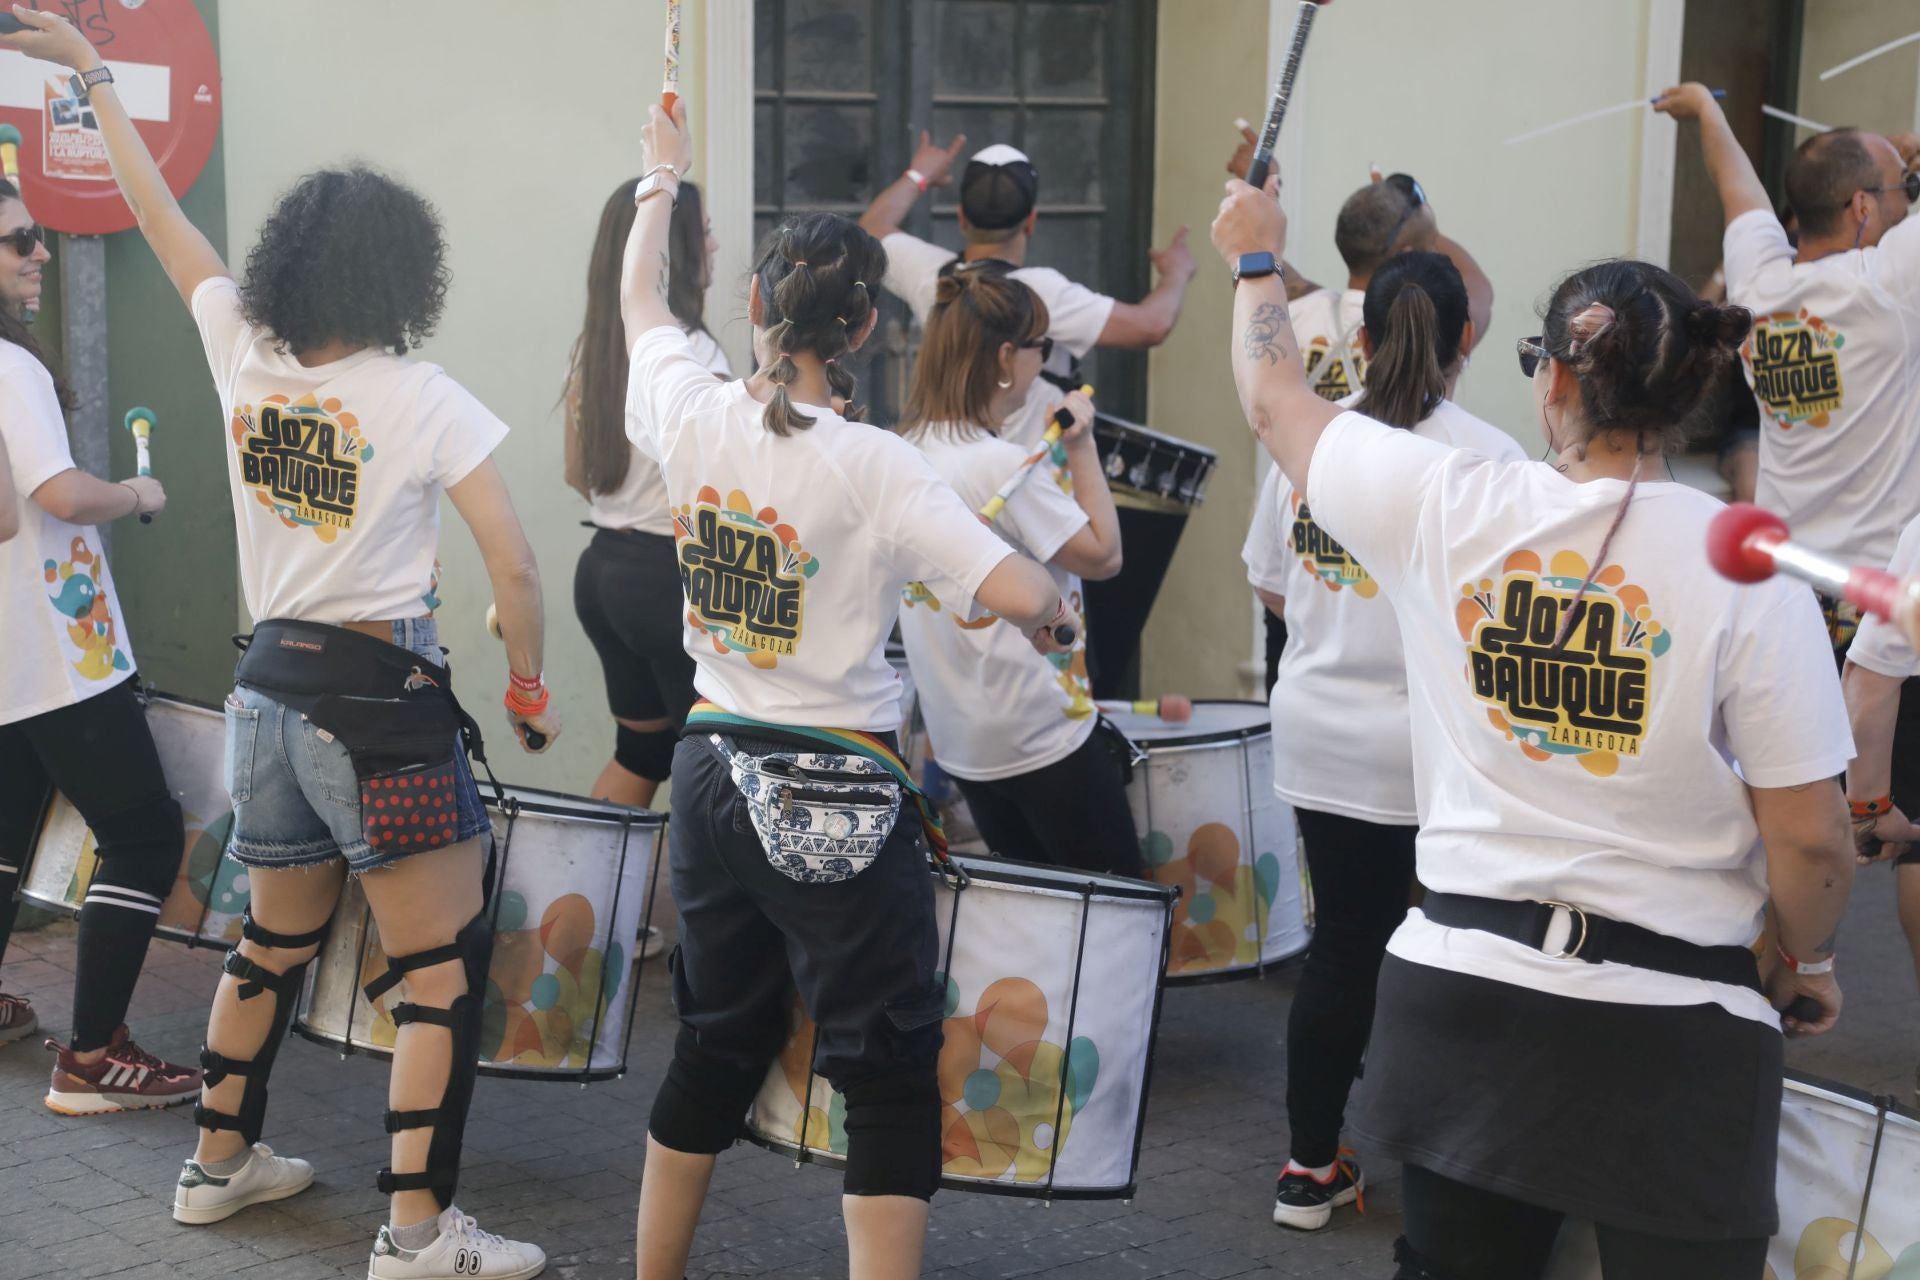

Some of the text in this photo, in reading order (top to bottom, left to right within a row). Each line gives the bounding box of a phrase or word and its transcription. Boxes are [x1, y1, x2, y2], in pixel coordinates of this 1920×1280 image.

[242, 448, 357, 516] BATUQUE
[297, 505, 351, 529] ZARAGOZA
[732, 626, 793, 655] ZARAGOZA
[1471, 643, 1646, 736] BATUQUE
[1551, 726, 1638, 754] ZARAGOZA
